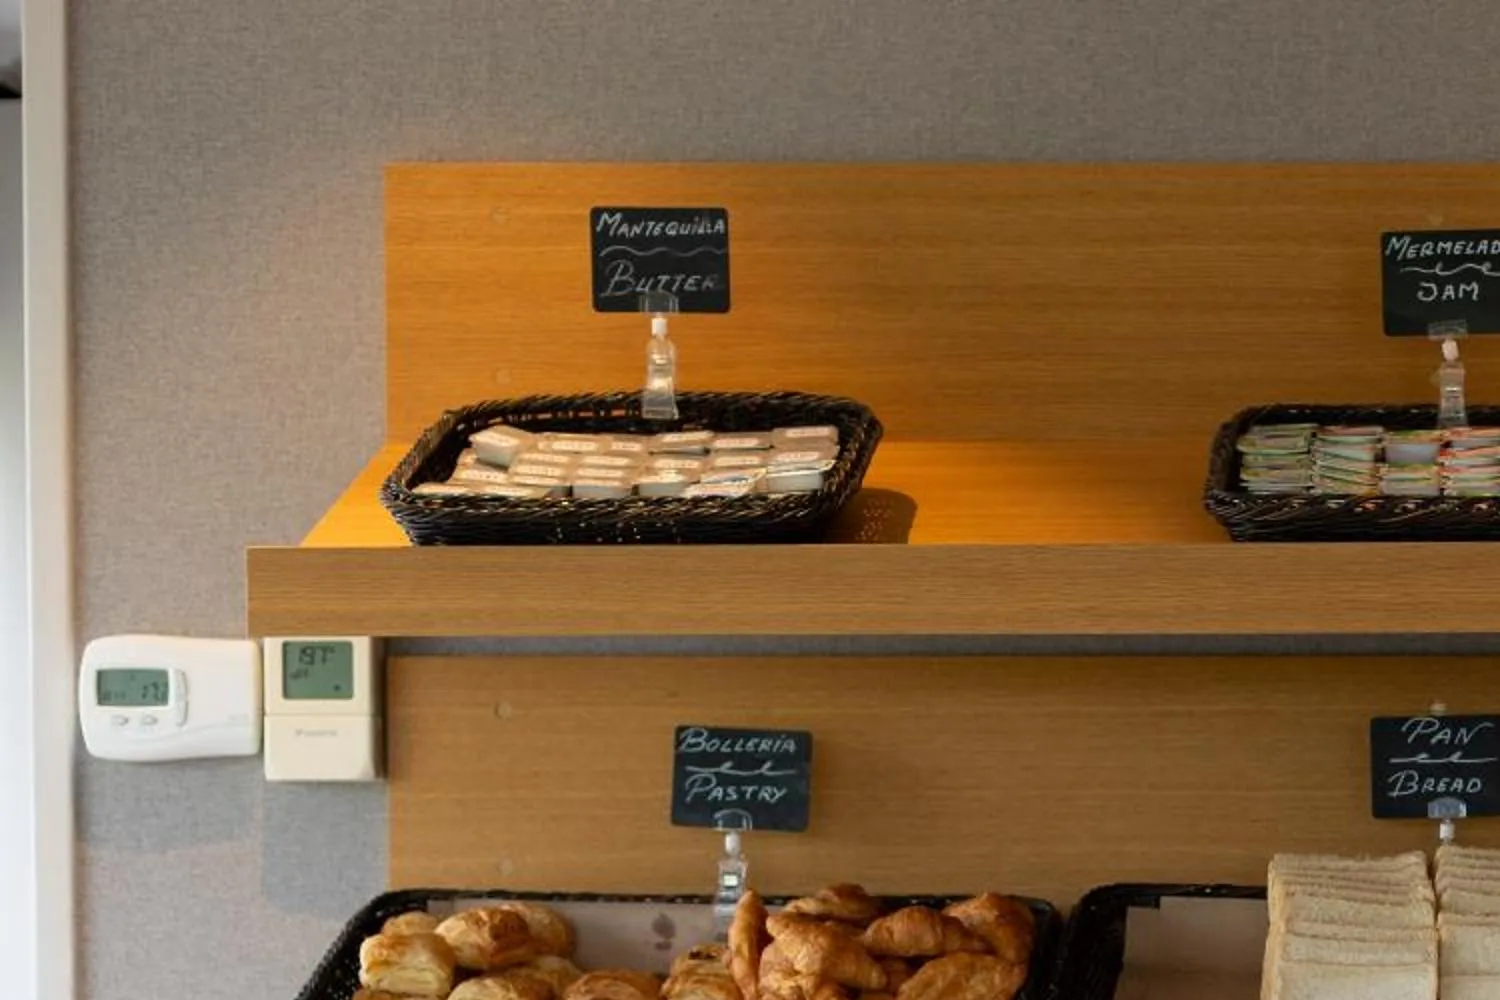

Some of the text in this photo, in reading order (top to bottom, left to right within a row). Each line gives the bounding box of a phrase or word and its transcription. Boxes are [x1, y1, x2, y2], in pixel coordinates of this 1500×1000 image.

[1416, 281, 1479, 301] JAM
[1401, 717, 1496, 745] PAN
[685, 773, 788, 804] PASTRY
[1387, 769, 1483, 798] BREAD
